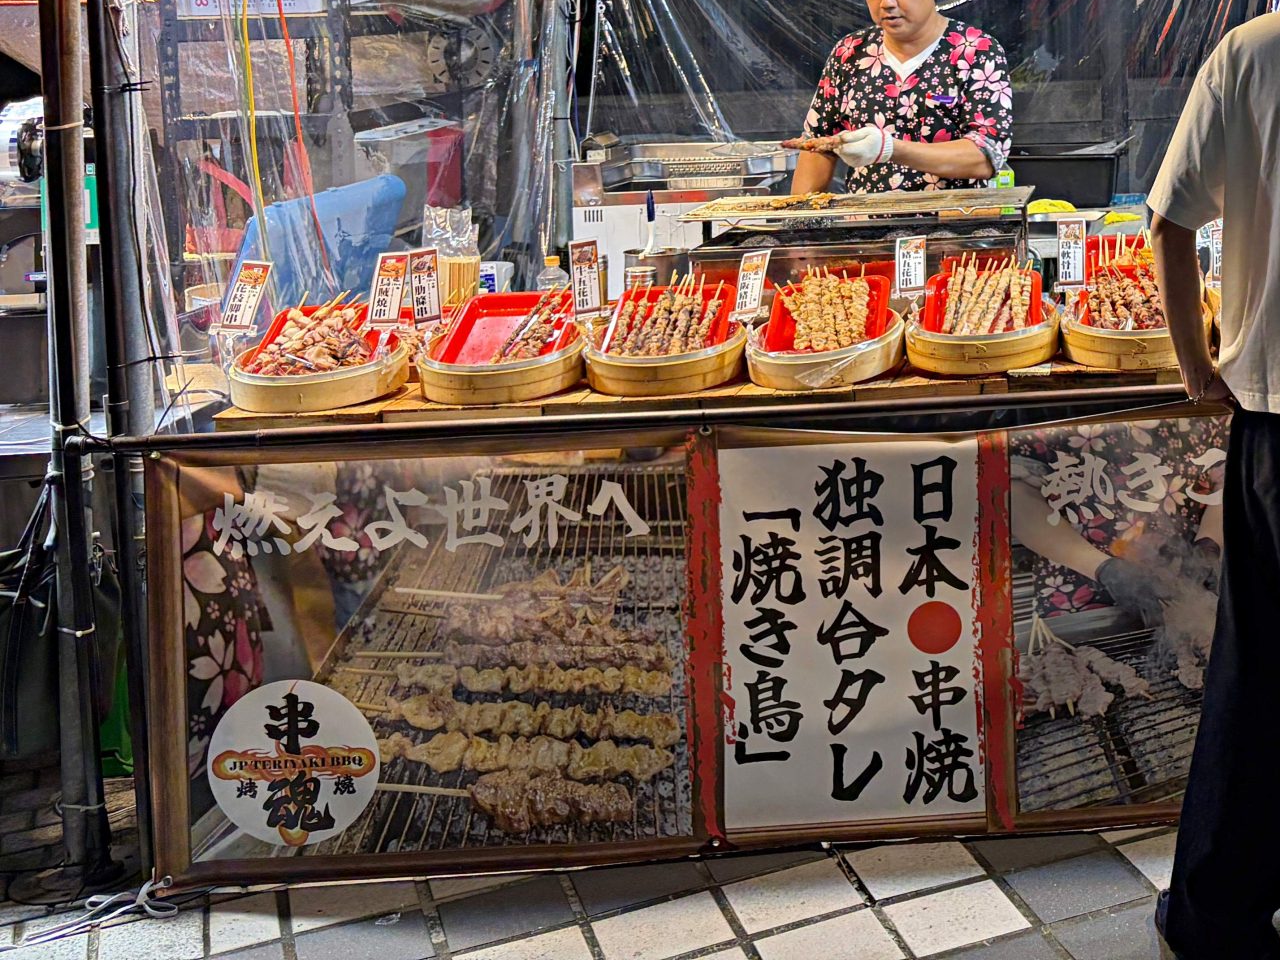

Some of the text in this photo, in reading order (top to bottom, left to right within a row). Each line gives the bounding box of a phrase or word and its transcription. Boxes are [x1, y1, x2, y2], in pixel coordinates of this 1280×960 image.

[212, 473, 651, 556] 燃えよ世界へ
[730, 507, 806, 765] 「焼き鳥」
[813, 457, 889, 801] 独調合タレ
[898, 455, 979, 805] 日本 串焼
[229, 755, 364, 771] JP TERIYAKI BBQ
[264, 693, 320, 755] 串
[263, 770, 335, 832] 魂
